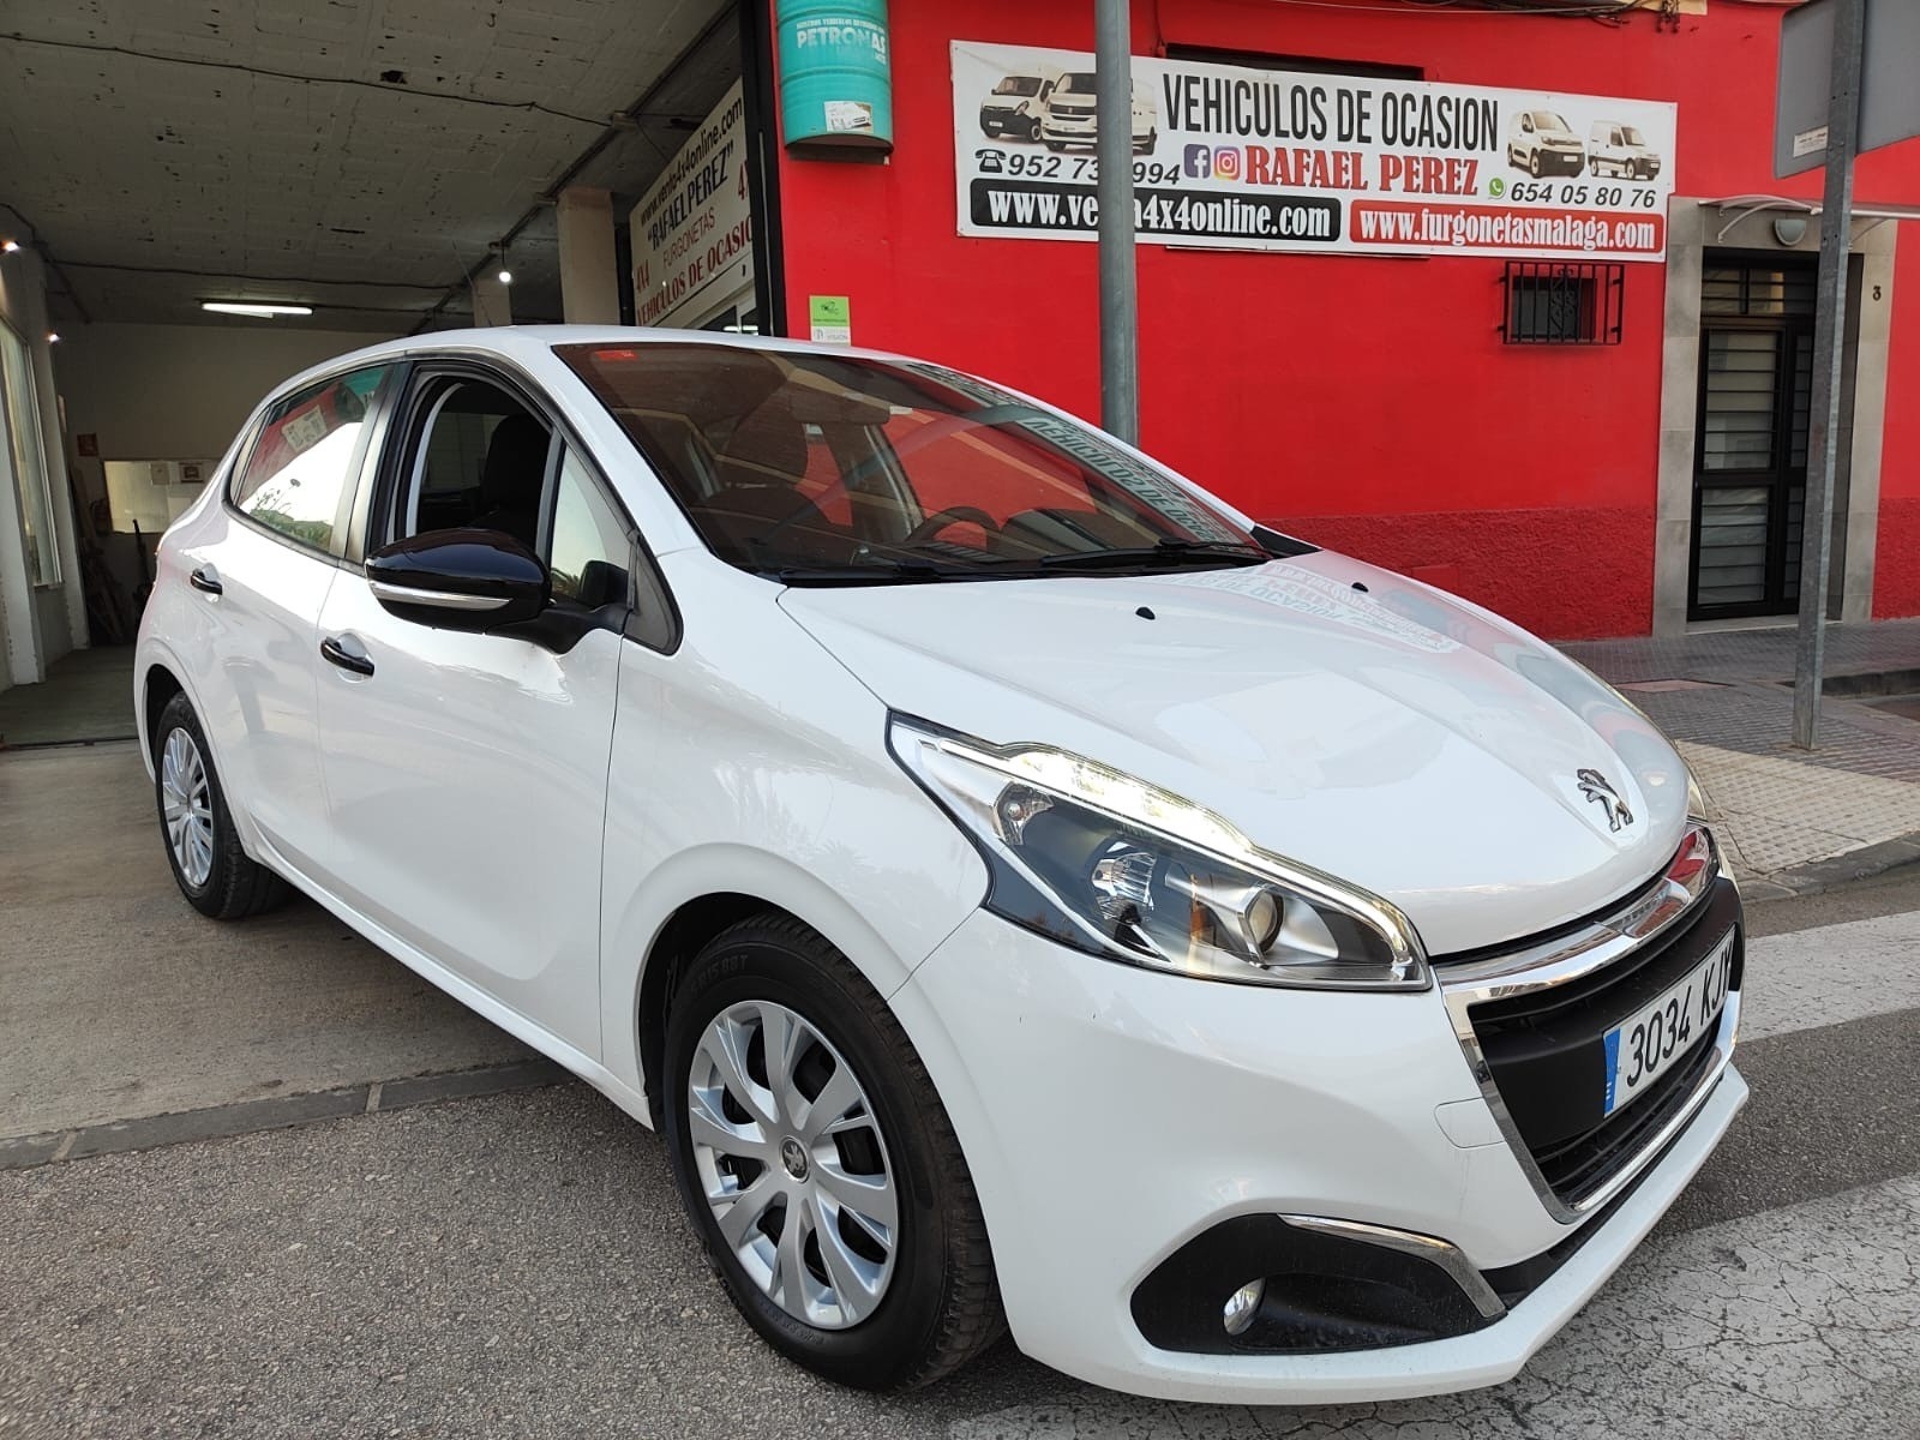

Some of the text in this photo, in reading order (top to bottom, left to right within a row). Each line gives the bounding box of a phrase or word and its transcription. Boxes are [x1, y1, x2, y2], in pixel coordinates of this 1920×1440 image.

[796, 26, 886, 54] PETRONAS
[1163, 73, 1499, 151] VEHICULOS DE OCASION
[1007, 154, 1062, 178] 952
[1072, 158, 1099, 180] 73
[1245, 145, 1479, 195] RAFAEL PEREZ
[1511, 182, 1656, 208] 654 05 80 76
[663, 206, 716, 270] FURGONETAS
[689, 256, 705, 288] DE
[707, 214, 752, 273] OCASIO
[1360, 208, 1656, 250] www.furgonetasmalaga.com
[1872, 284, 1882, 302] 3
[1626, 984, 1693, 1088] 3034
